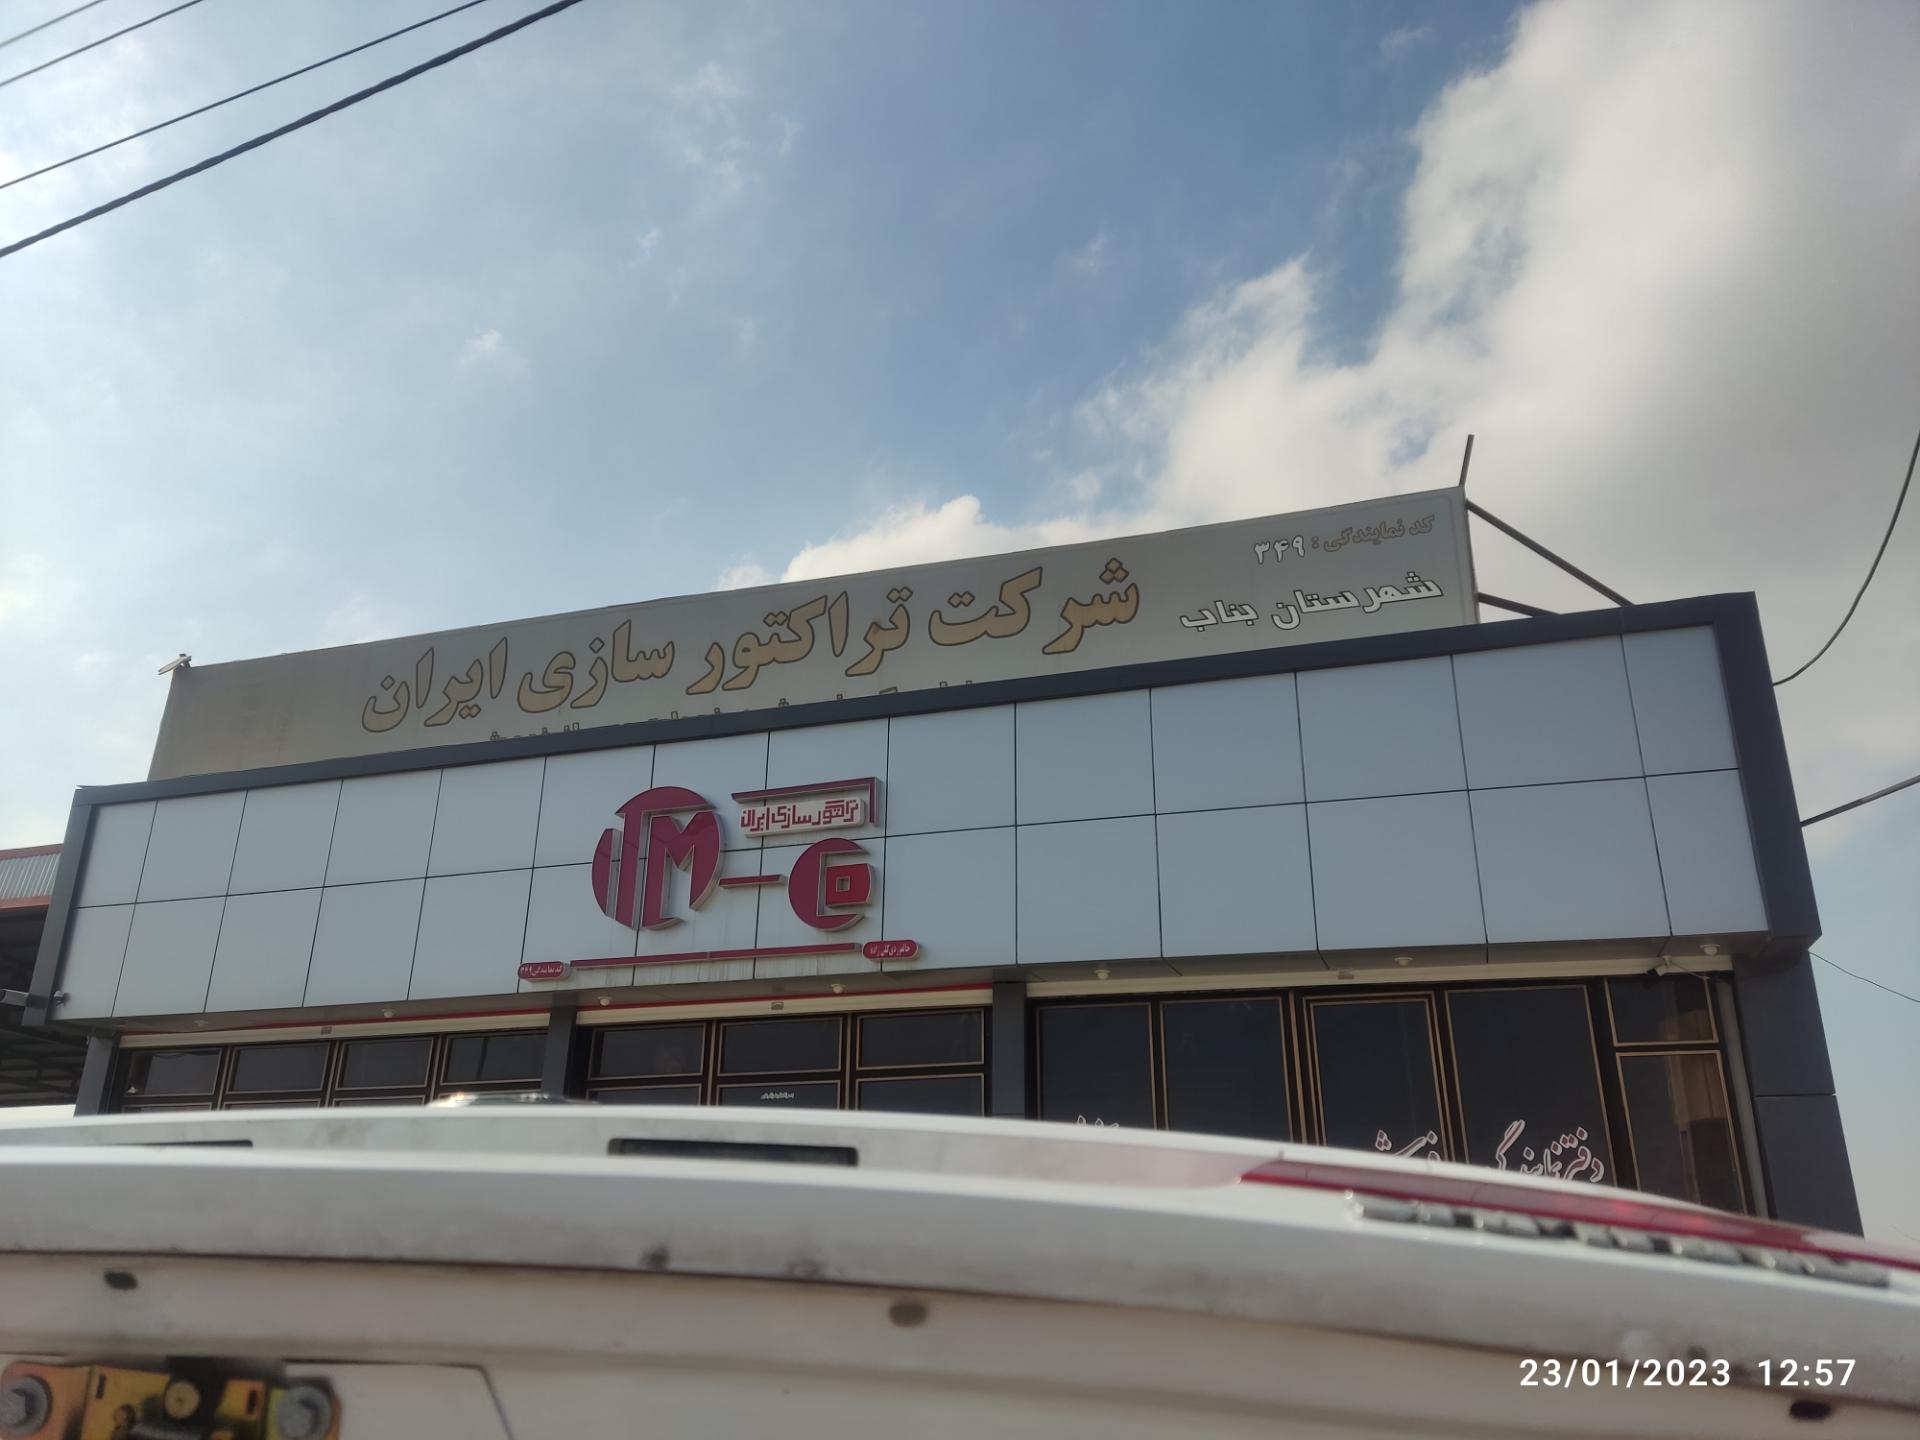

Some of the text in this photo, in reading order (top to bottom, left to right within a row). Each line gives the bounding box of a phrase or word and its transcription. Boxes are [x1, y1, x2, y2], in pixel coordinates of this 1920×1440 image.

[1253, 534, 1306, 565] ۳۴۹
[1408, 514, 1436, 536] کد
[928, 557, 1140, 655] شرکت
[1178, 570, 1444, 632] شهرستان بناب
[517, 619, 676, 714] سازی
[686, 586, 913, 696] تراکتور
[361, 636, 508, 733] ایران
[740, 807, 771, 833] ایران
